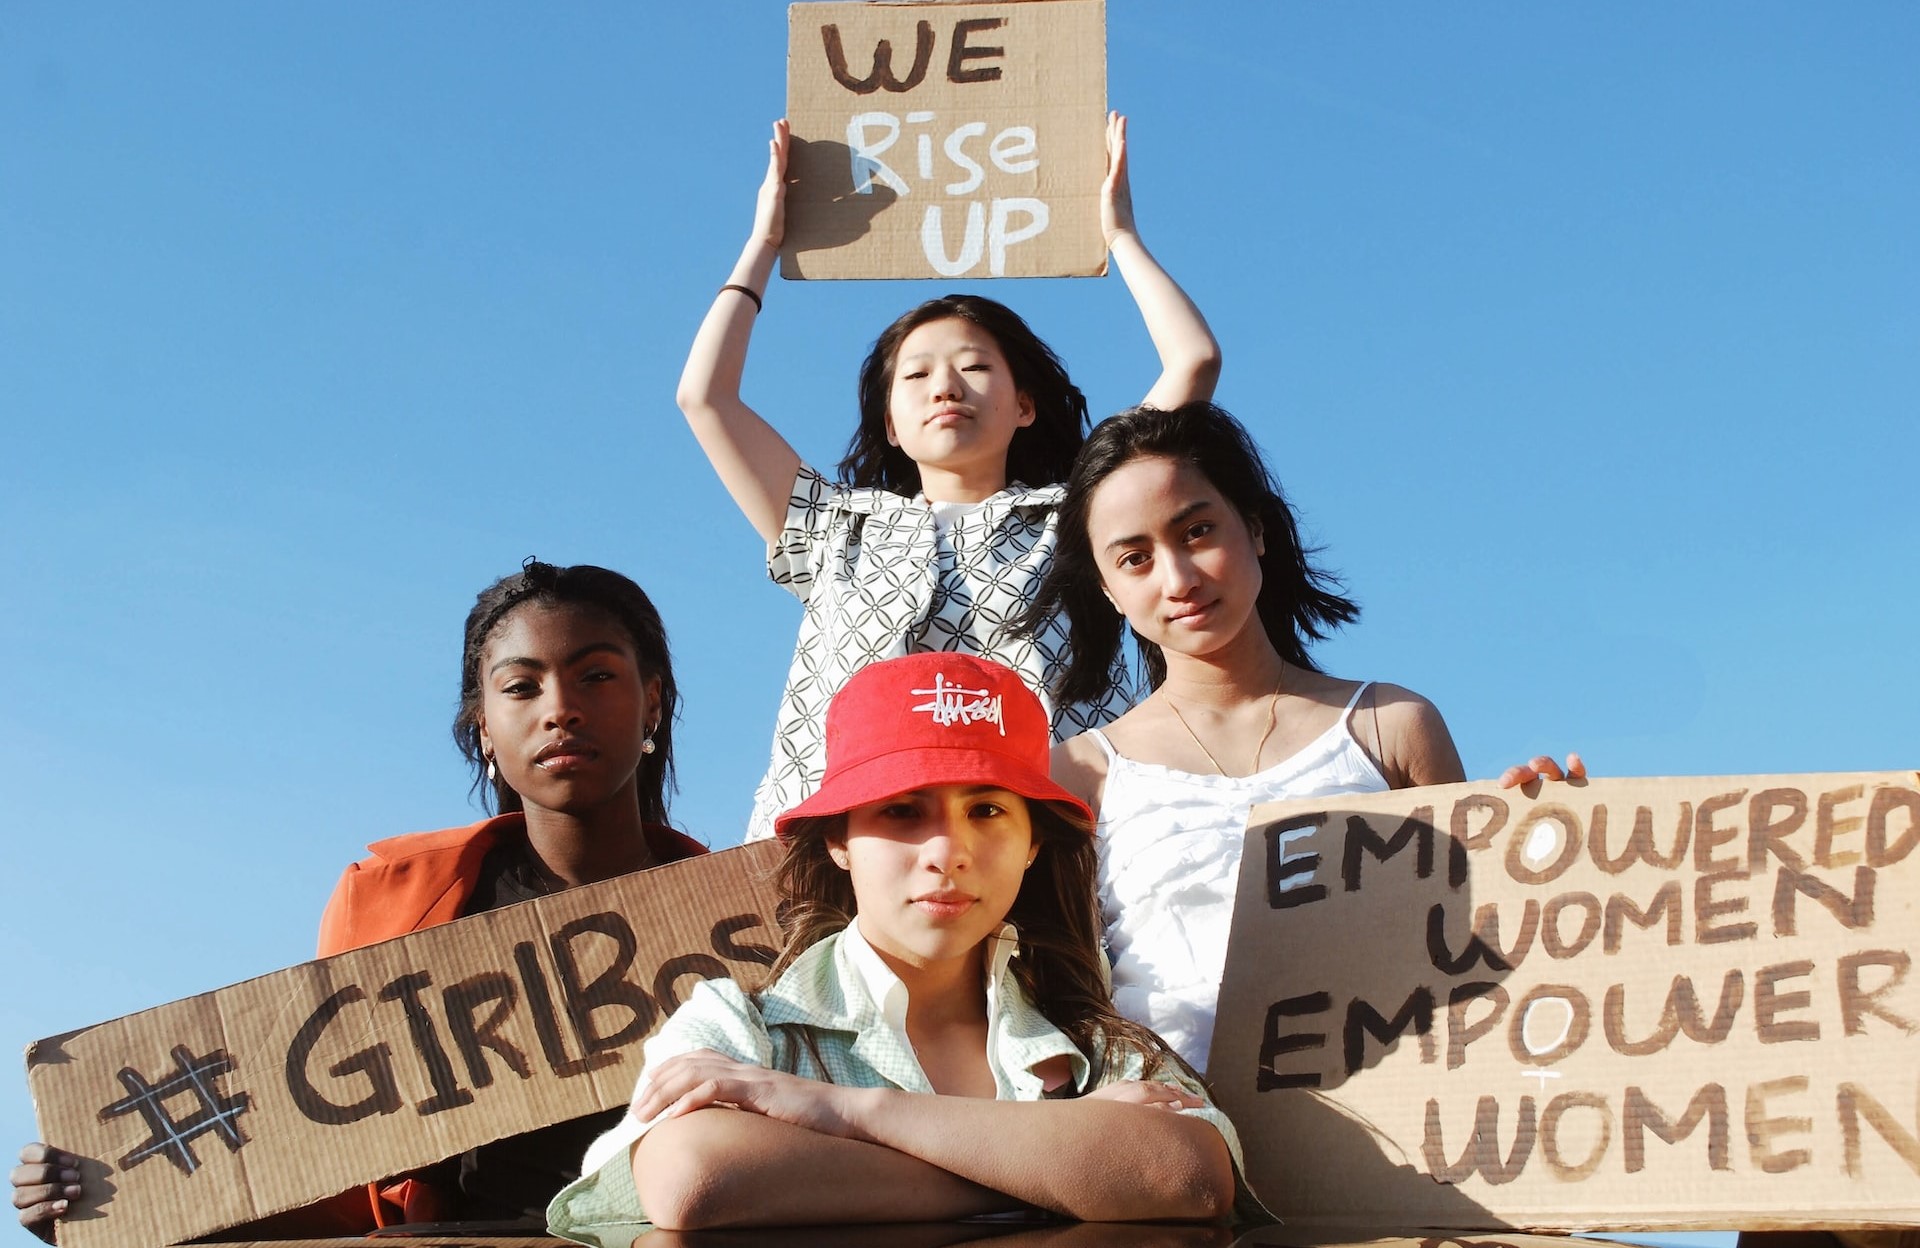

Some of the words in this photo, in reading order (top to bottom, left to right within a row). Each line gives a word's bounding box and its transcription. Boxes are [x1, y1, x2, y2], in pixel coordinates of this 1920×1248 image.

[821, 17, 1009, 96] WE
[847, 111, 1040, 196] Rise
[921, 198, 1050, 277] UP
[1265, 785, 1920, 910] EMPOWERED
[1426, 865, 1878, 975] WOMEN
[96, 898, 800, 1178] #GIRLBOS
[1256, 949, 1919, 1093] EMPOWER
[1420, 1075, 1920, 1185] WOMEN
